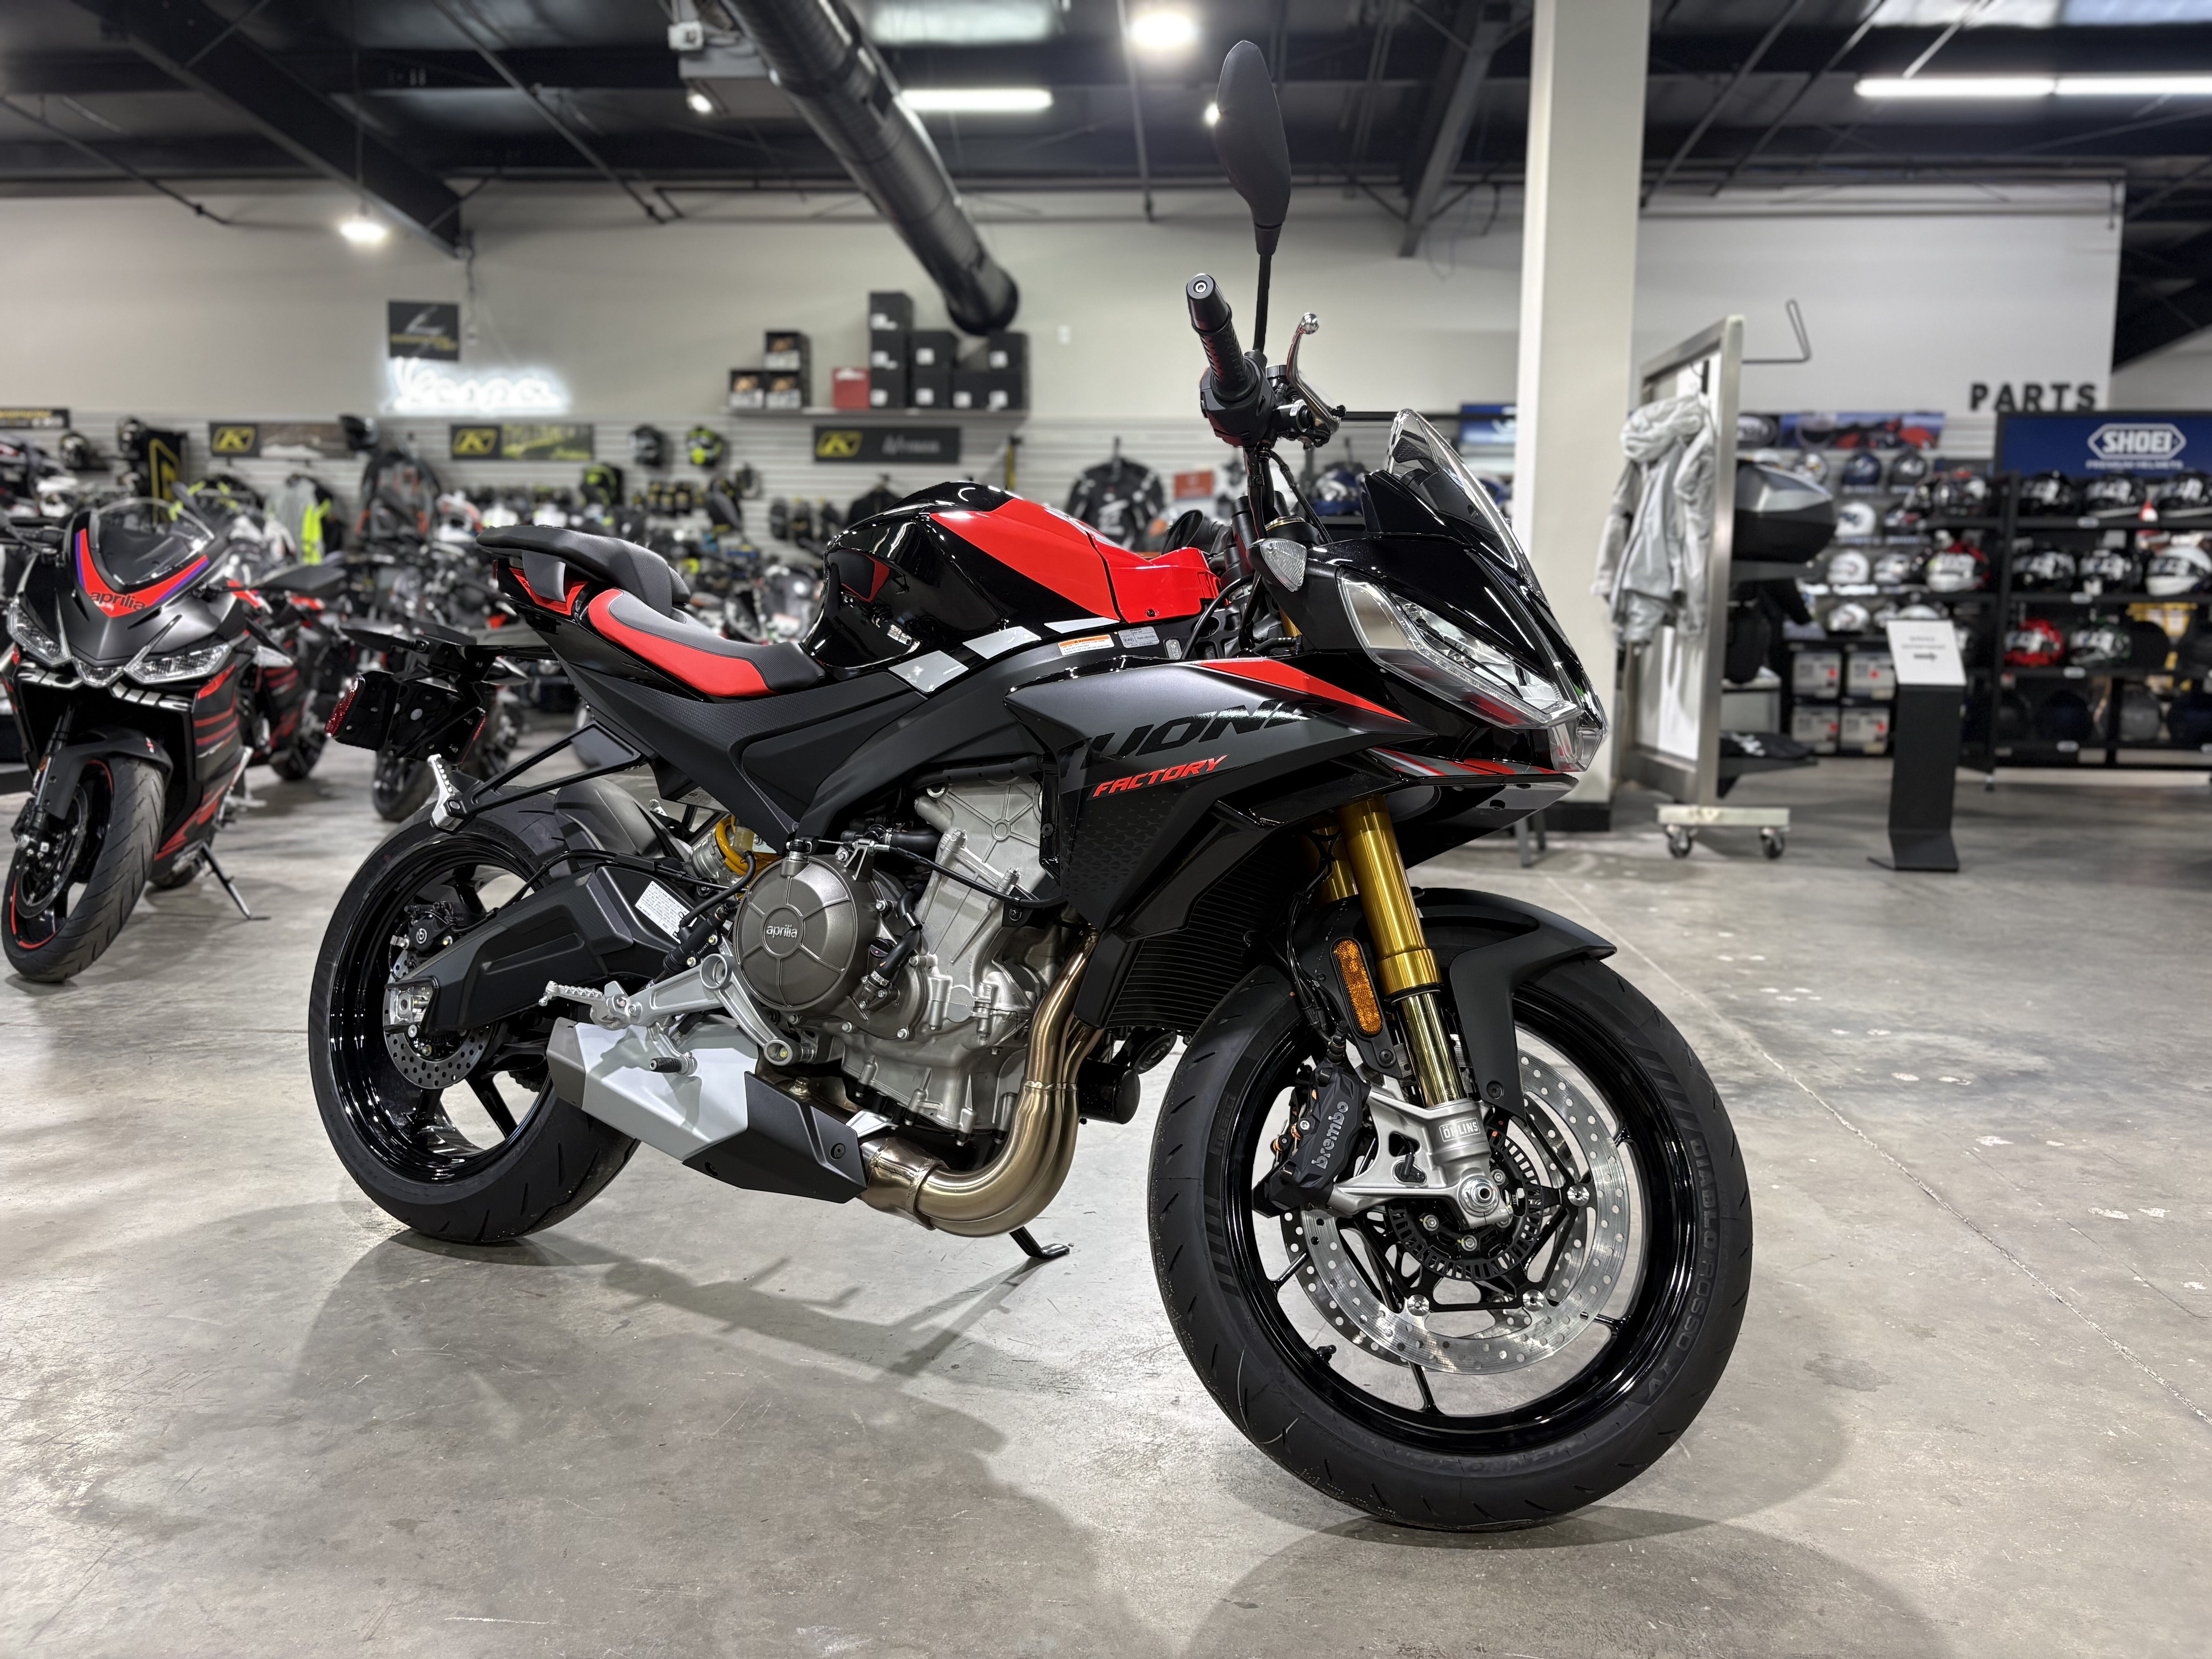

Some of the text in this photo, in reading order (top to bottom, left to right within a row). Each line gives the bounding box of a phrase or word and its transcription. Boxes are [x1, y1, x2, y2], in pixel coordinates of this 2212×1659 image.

[1970, 383, 2098, 412] PARTS
[2103, 431, 2172, 453] SHOEI
[89, 590, 146, 611] aprilia
[1092, 754, 1229, 798] FACTORY
[766, 924, 798, 940] aprilia
[1311, 1101, 1349, 1170] brembo
[1442, 1121, 1479, 1139] ÖHLINS
[1690, 1139, 1717, 1249] DIABLO
